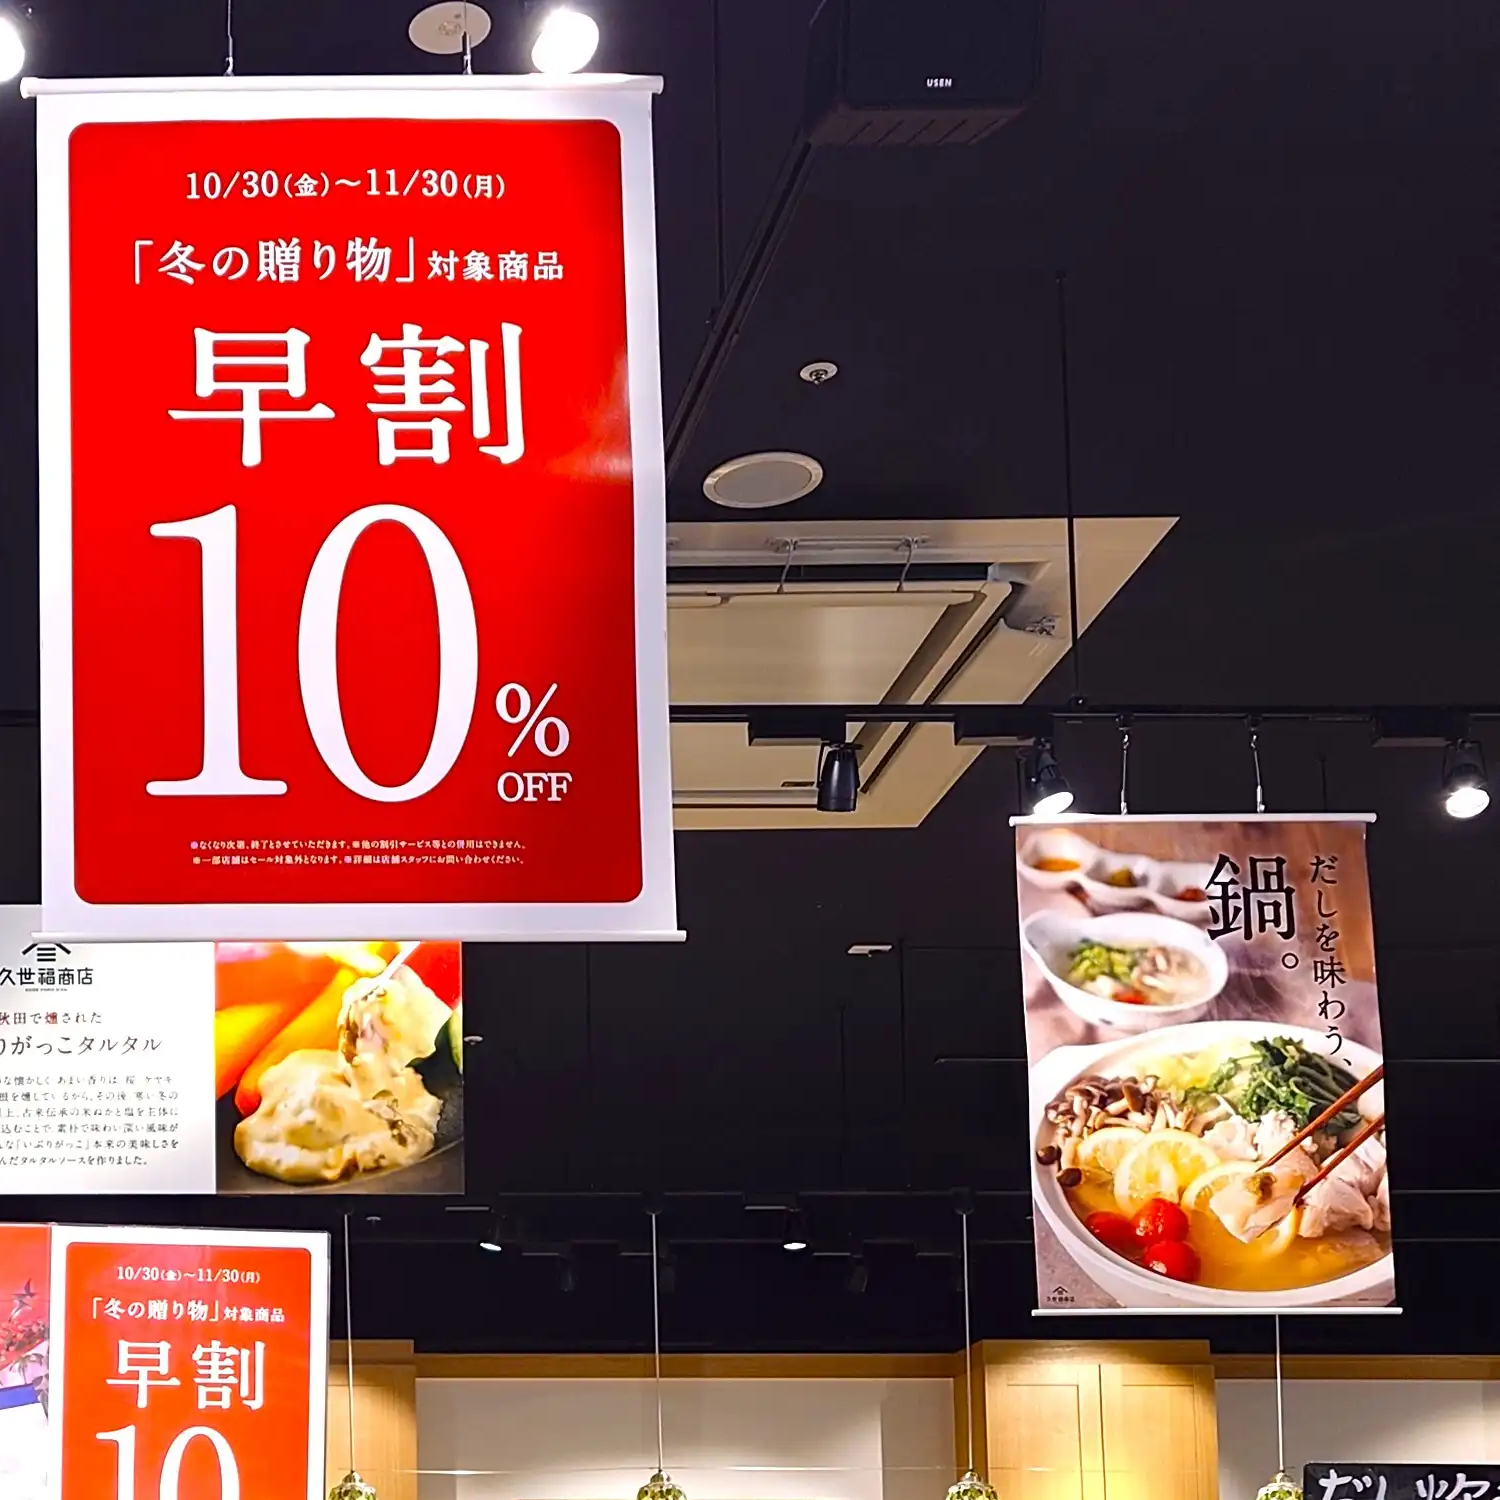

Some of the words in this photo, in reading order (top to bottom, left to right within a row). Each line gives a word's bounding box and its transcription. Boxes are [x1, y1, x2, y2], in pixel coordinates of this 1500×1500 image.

[926, 78, 953, 88] USEN
[167, 321, 526, 468] 早割
[496, 771, 573, 802] OFF
[1205, 853, 1300, 970] 鍋。
[1310, 855, 1354, 1067] だしを味わう、
[106, 1339, 267, 1411] 早割
